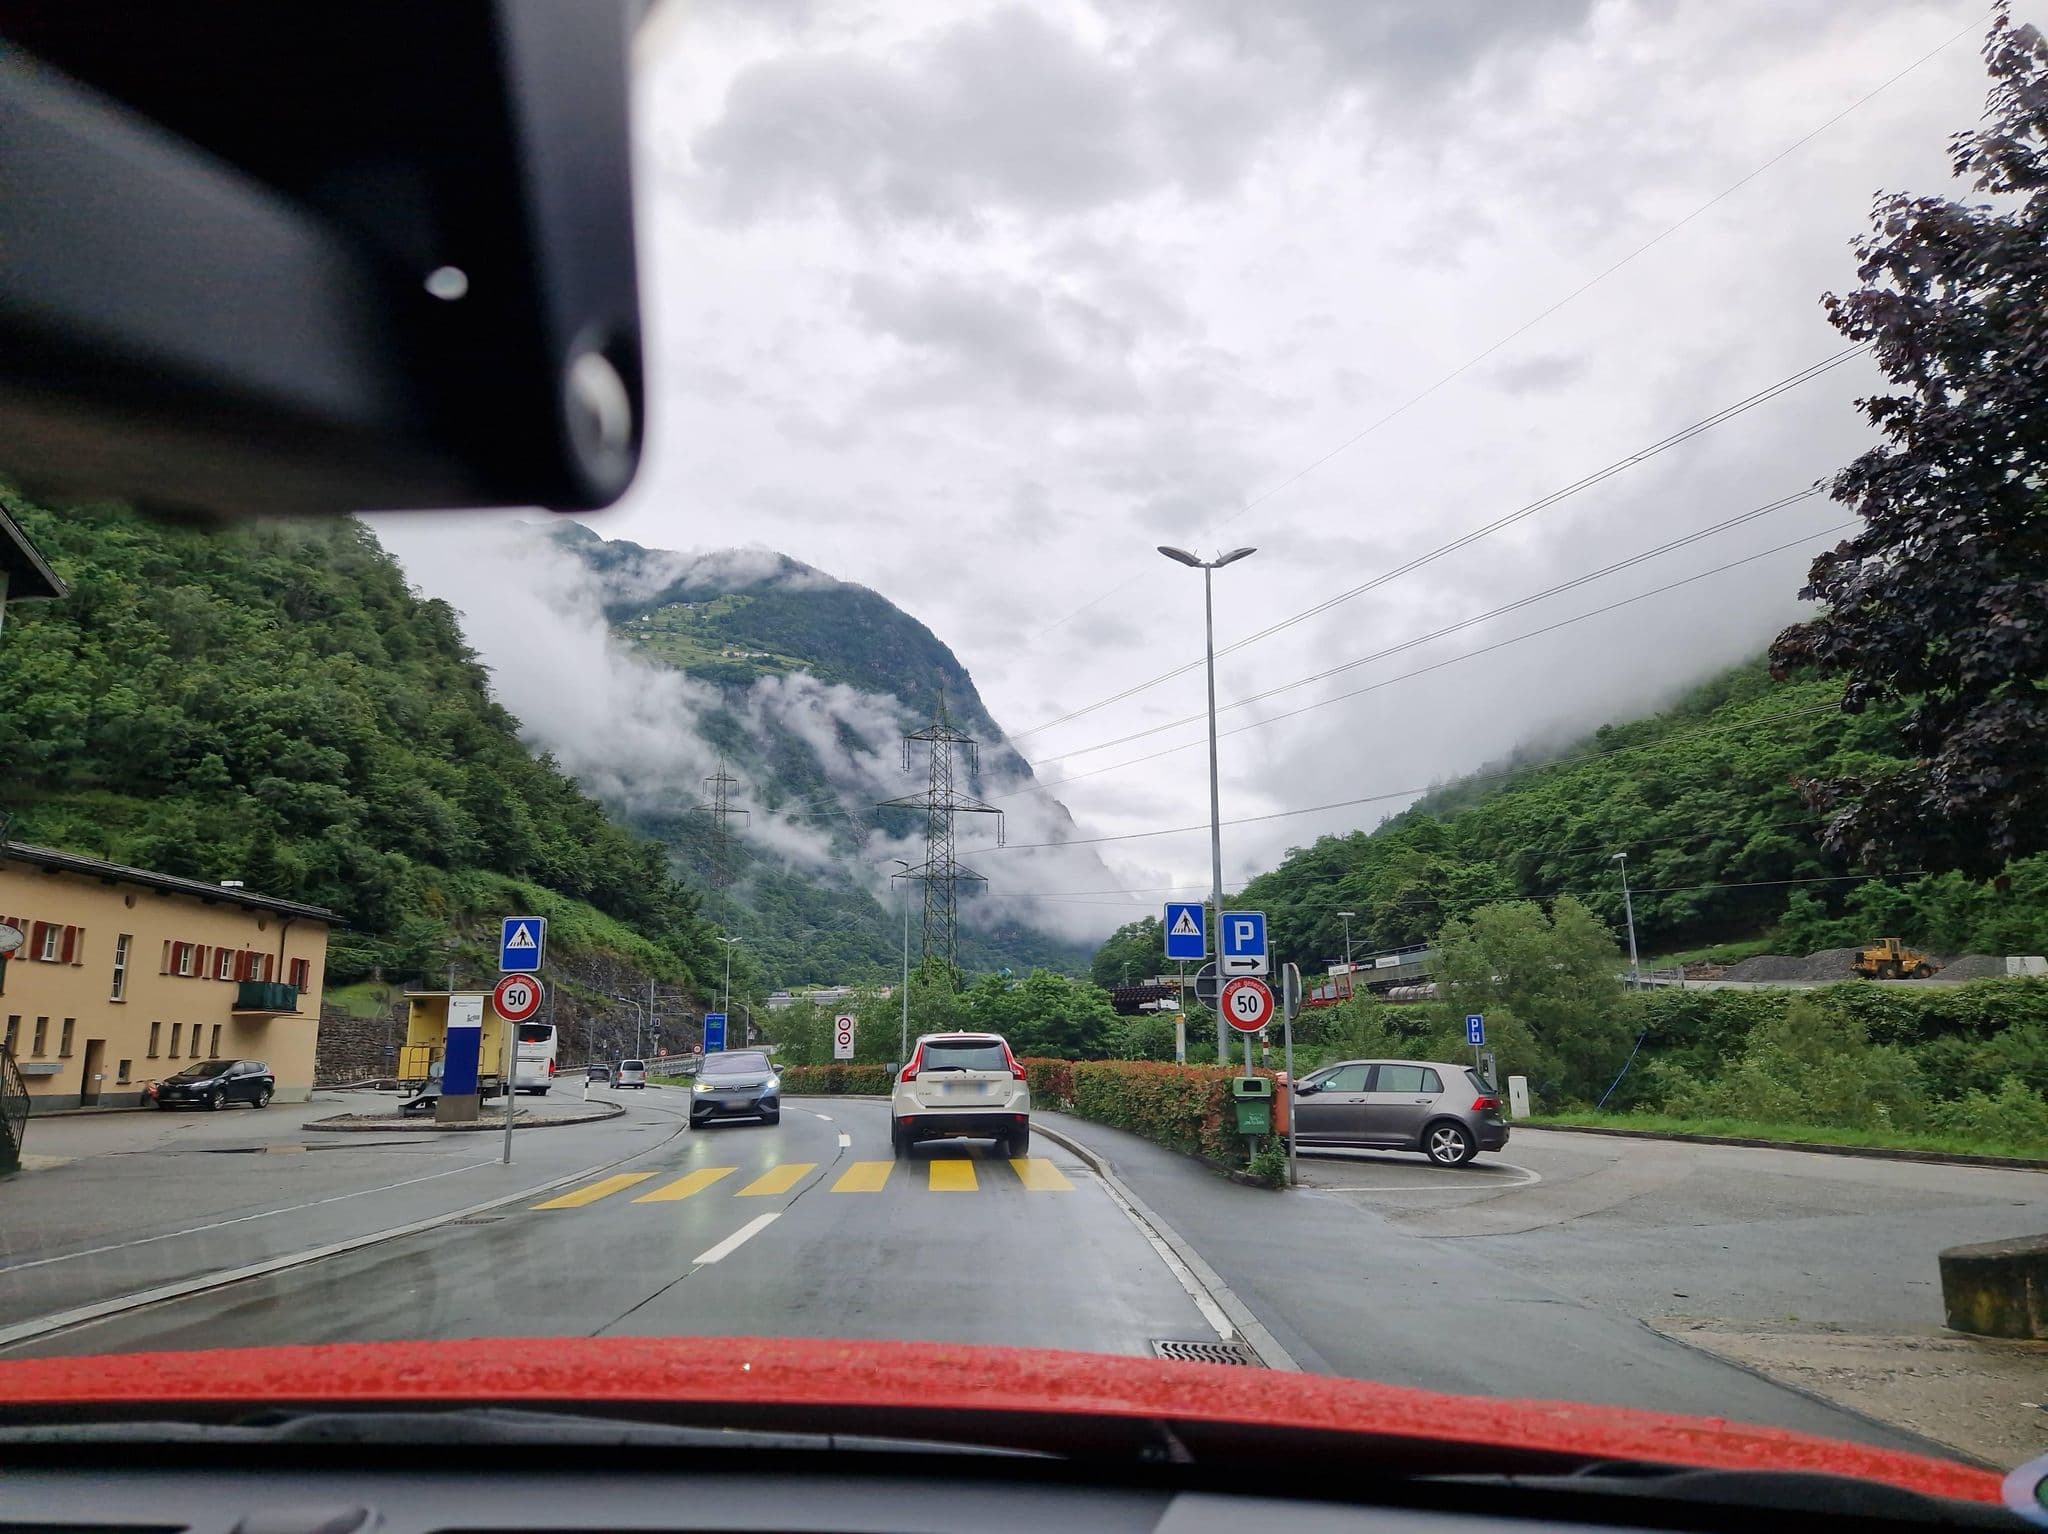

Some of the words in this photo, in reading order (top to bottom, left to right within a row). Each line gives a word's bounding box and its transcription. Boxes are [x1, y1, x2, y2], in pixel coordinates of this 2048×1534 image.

[1234, 921, 1254, 951] P
[508, 990, 526, 1006] 50
[1237, 995, 1257, 1014] 50
[1471, 1018, 1479, 1032] P
